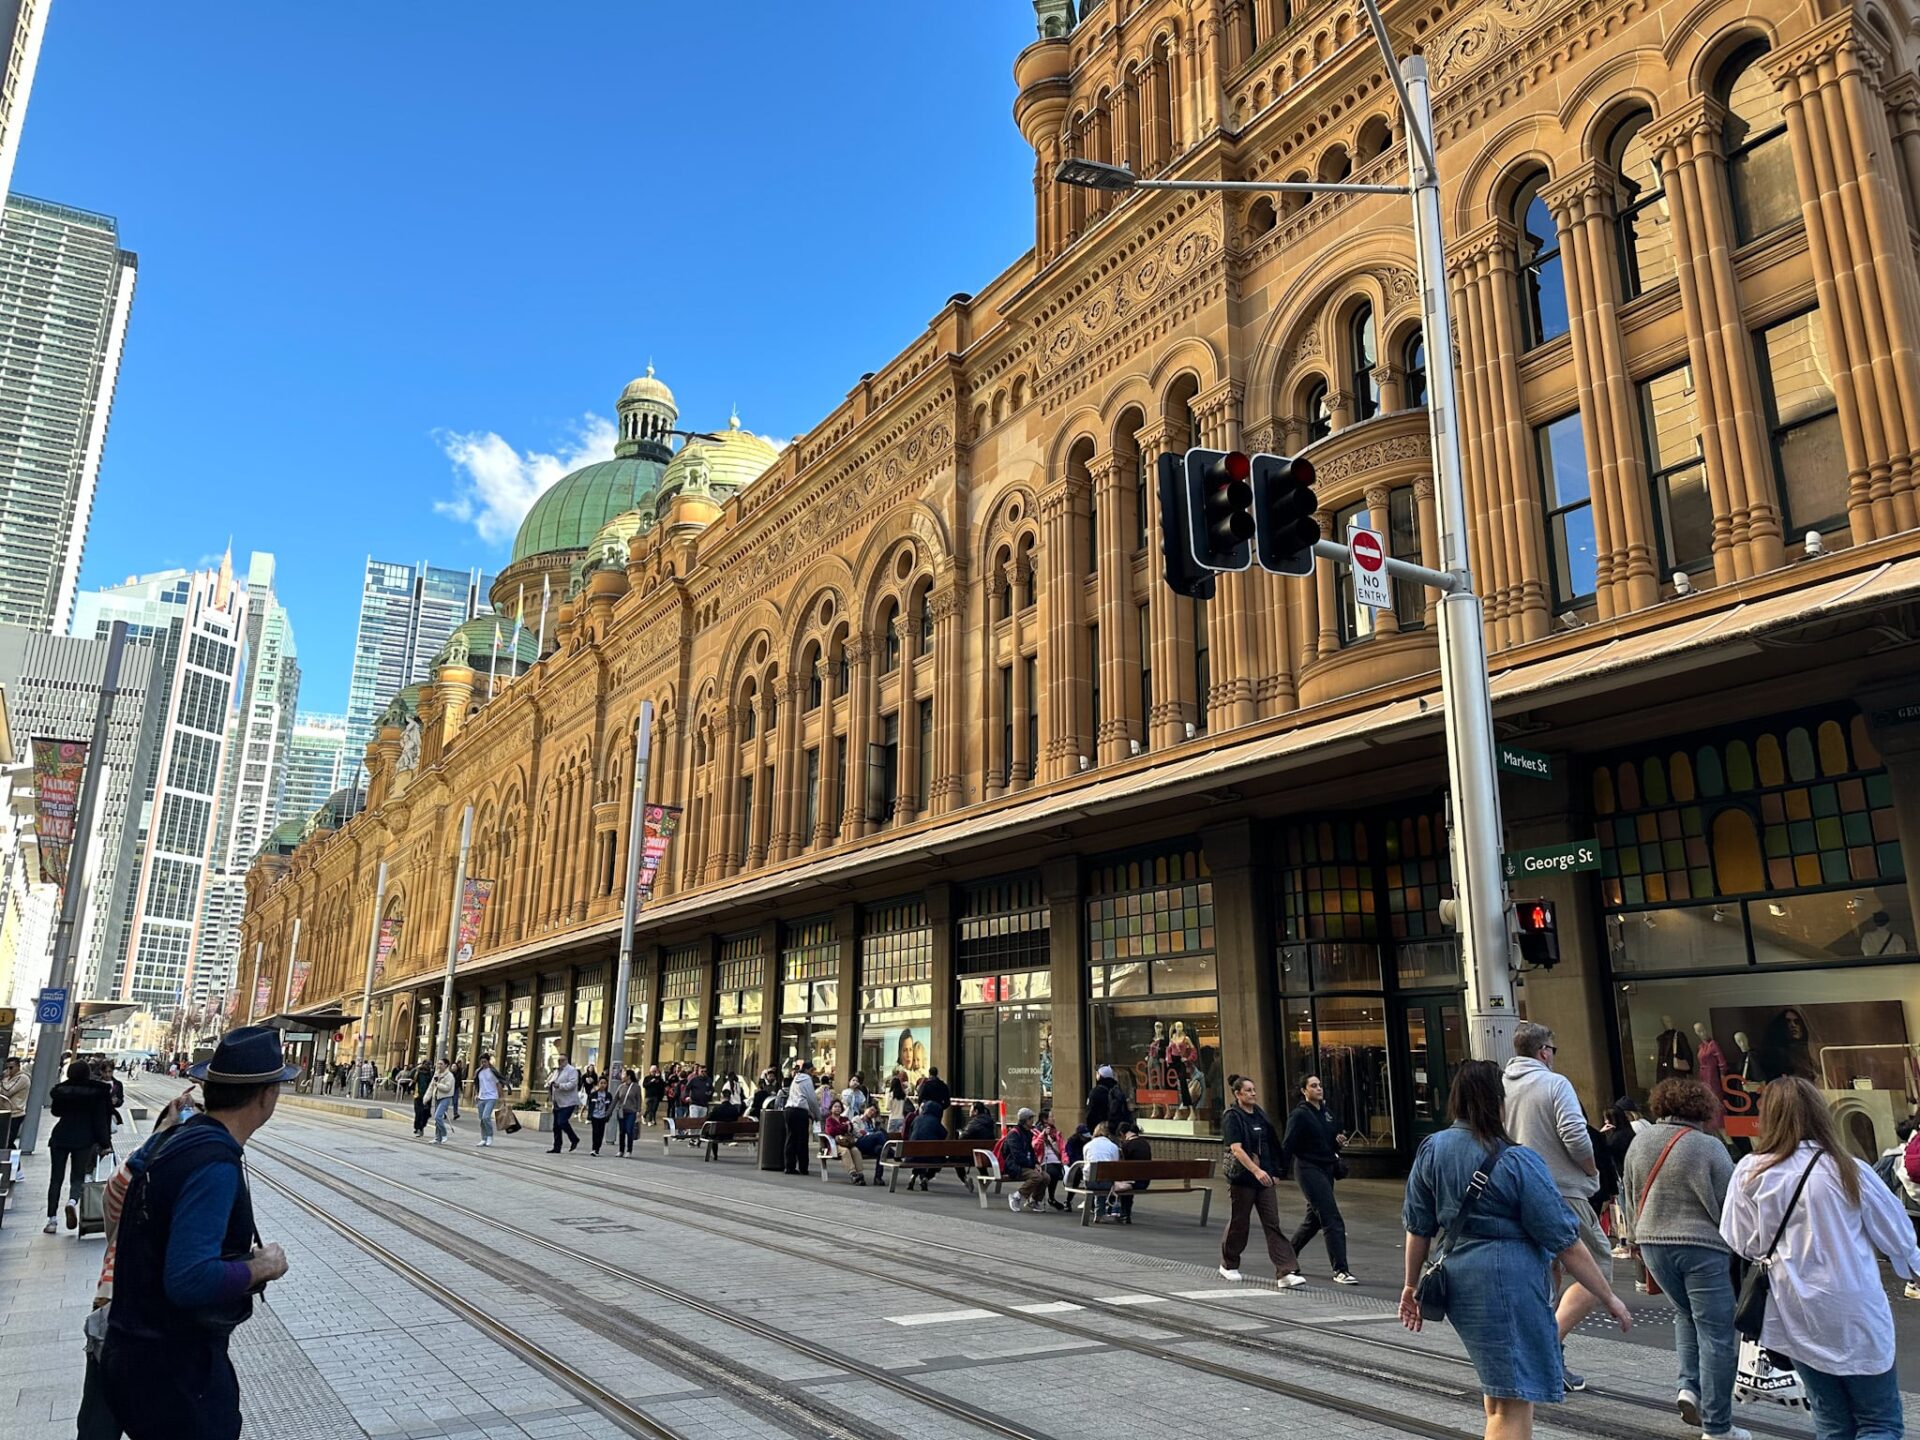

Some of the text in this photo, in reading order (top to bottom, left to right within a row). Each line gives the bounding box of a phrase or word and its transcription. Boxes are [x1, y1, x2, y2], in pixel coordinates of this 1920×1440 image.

[1363, 574, 1379, 588] NO
[1358, 588, 1387, 602] ENTRY
[1503, 751, 1548, 773] Market St
[1524, 848, 1593, 871] George St
[43, 1007, 57, 1017] 20
[1136, 1061, 1178, 1087] Sale
[1757, 1377, 1793, 1389] Locker
